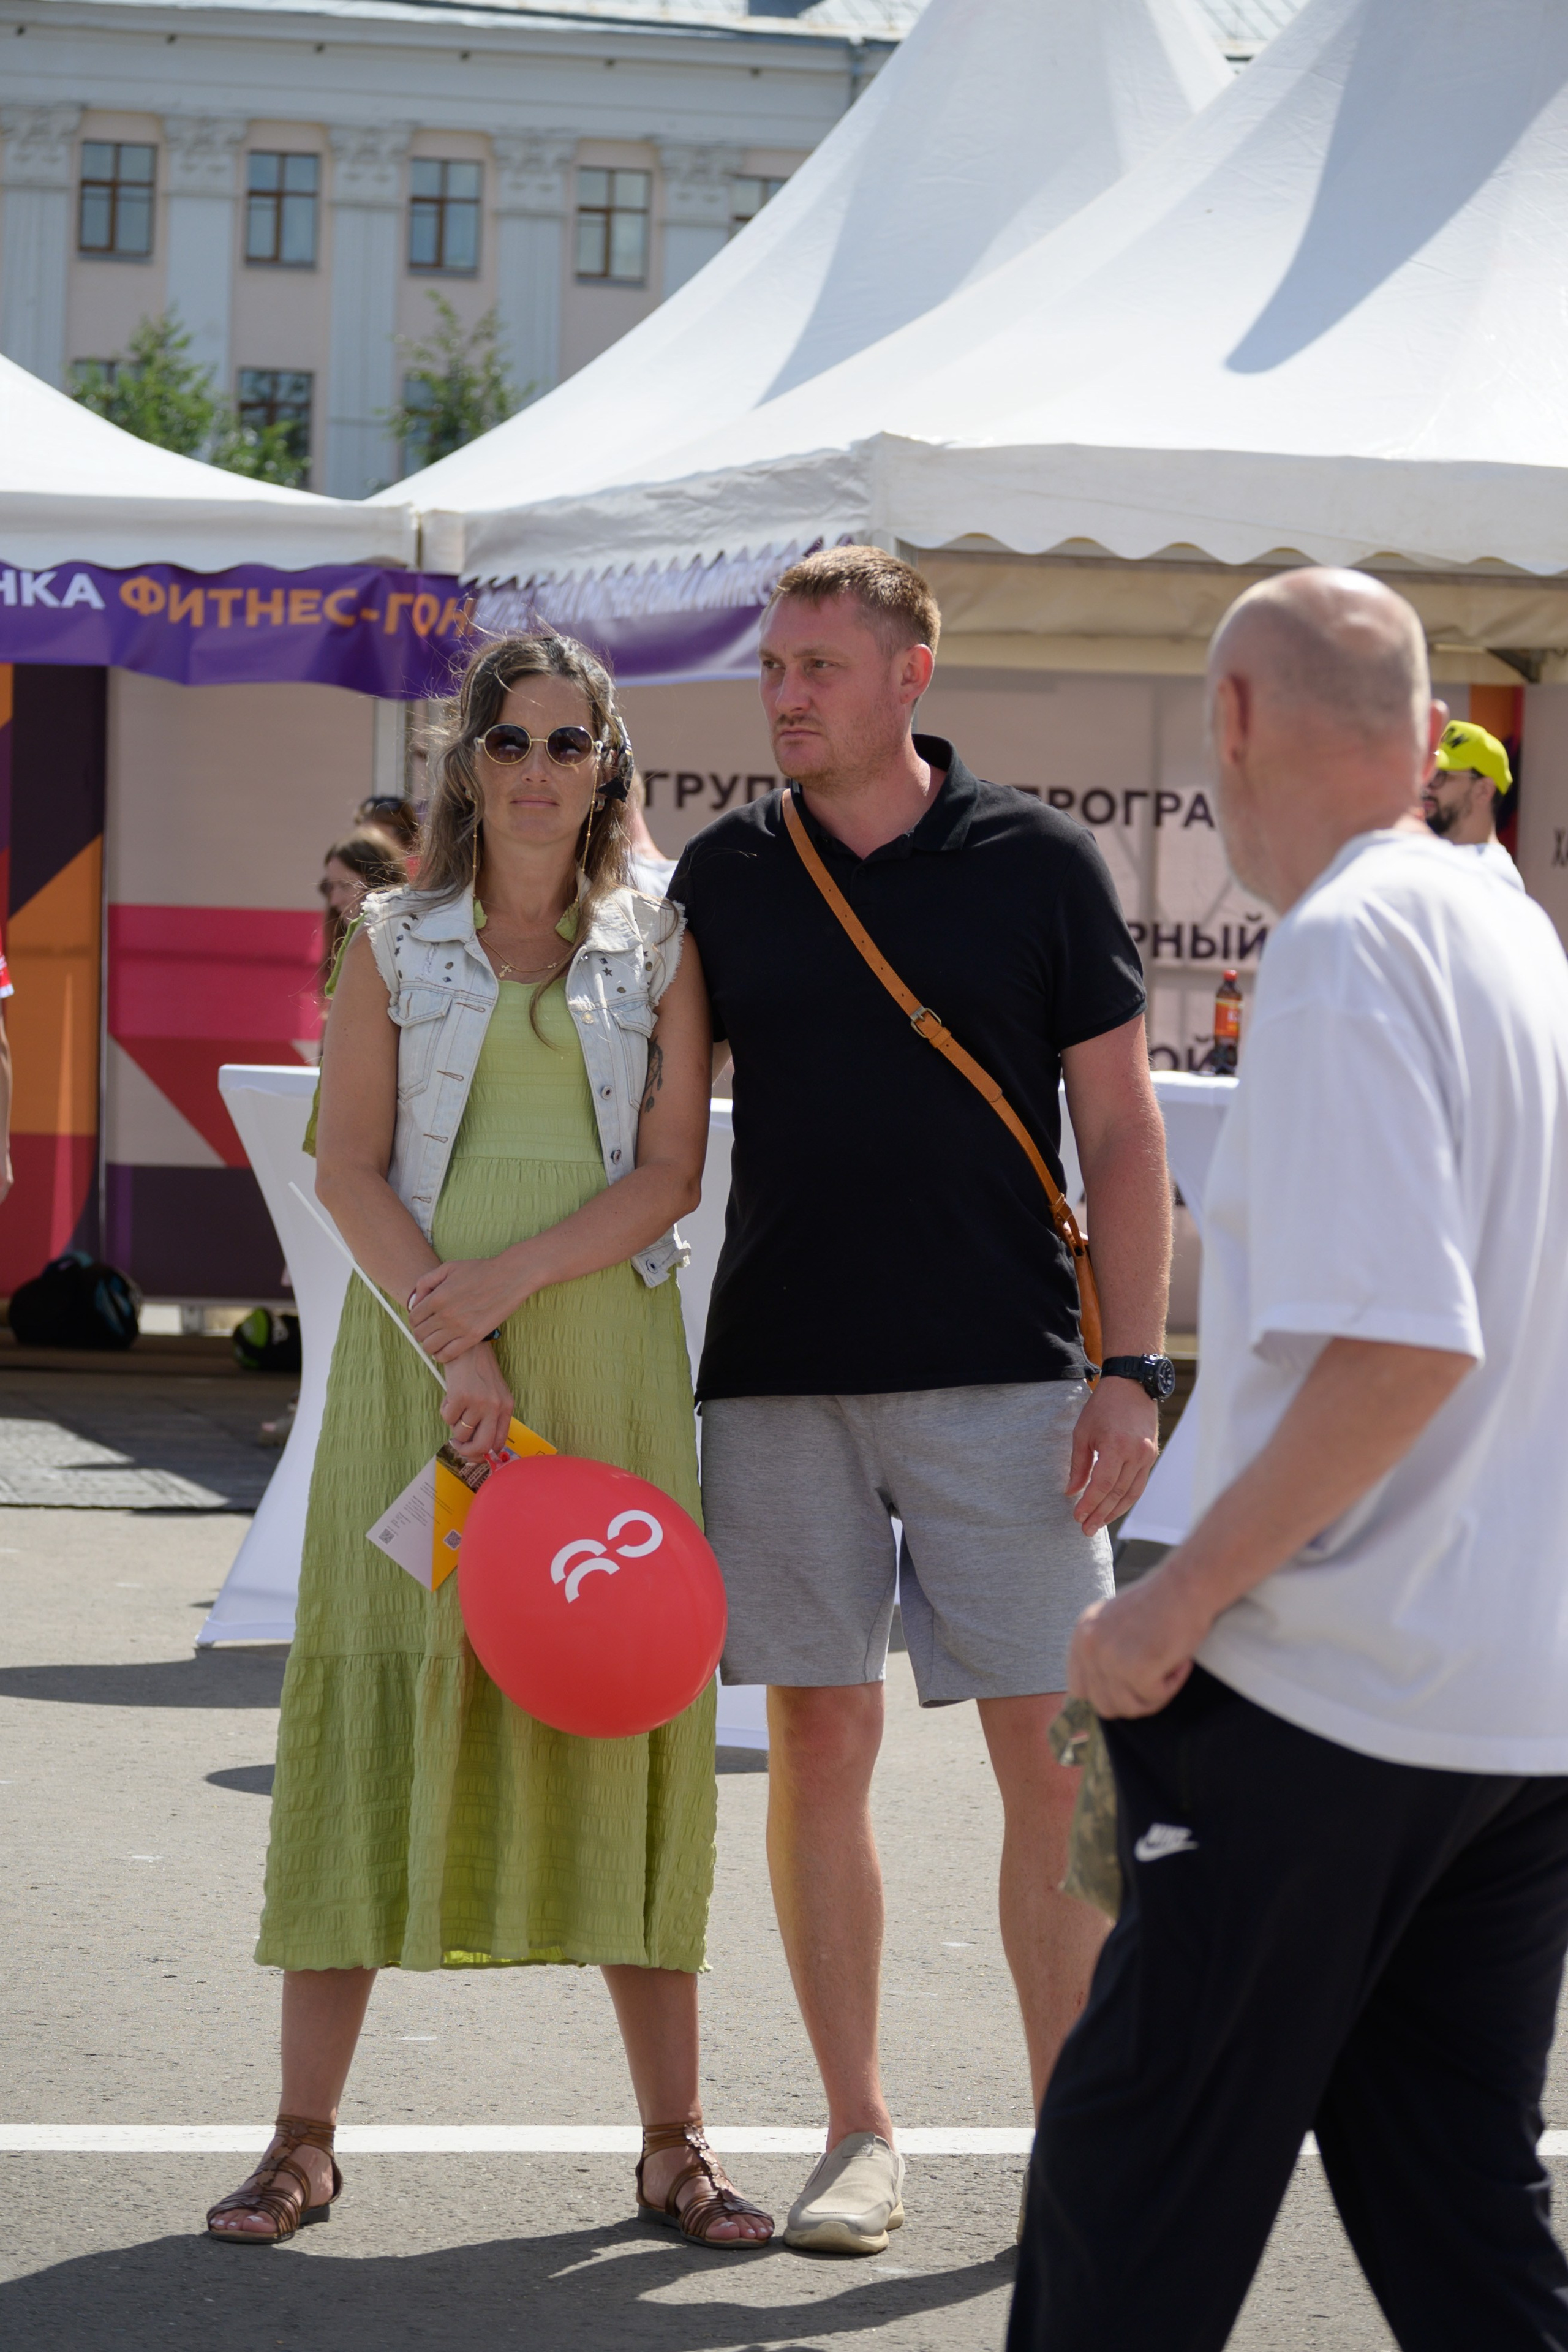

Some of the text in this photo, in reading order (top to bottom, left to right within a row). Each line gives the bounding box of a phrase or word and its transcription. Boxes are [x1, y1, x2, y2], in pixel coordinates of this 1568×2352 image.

[119, 576, 477, 637] ФИТНЕС-ГОН
[644, 770, 1215, 829] ГРУП РОГРА
